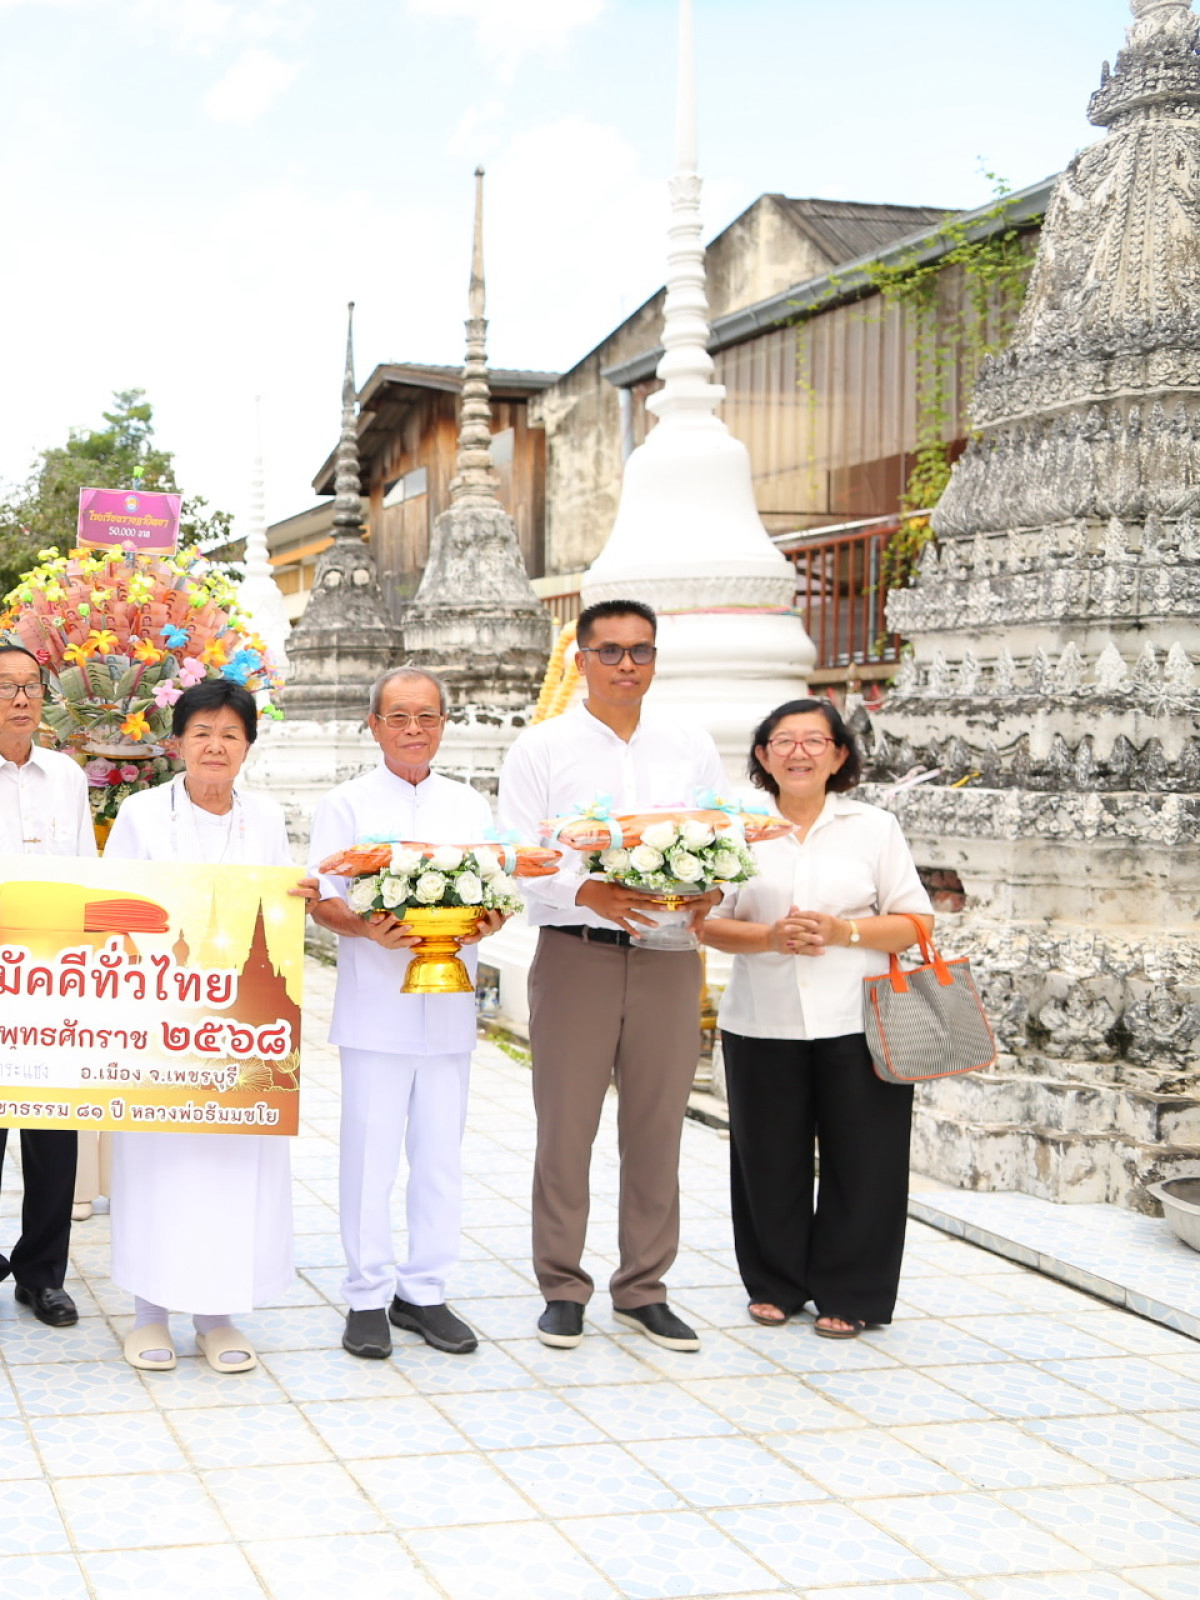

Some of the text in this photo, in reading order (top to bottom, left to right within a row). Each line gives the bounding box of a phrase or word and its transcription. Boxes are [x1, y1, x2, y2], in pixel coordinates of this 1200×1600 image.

[161, 1021, 286, 1055] ๒๕๖๘
[80, 1062, 141, 1081] อ.เมือง
[150, 1066, 238, 1090] จ.เพชรบุรี
[76, 1106, 103, 1118] ๘๑
[112, 1100, 124, 1119] ปี
[131, 1103, 280, 1124] หลวงพ่อธัมมชโย
